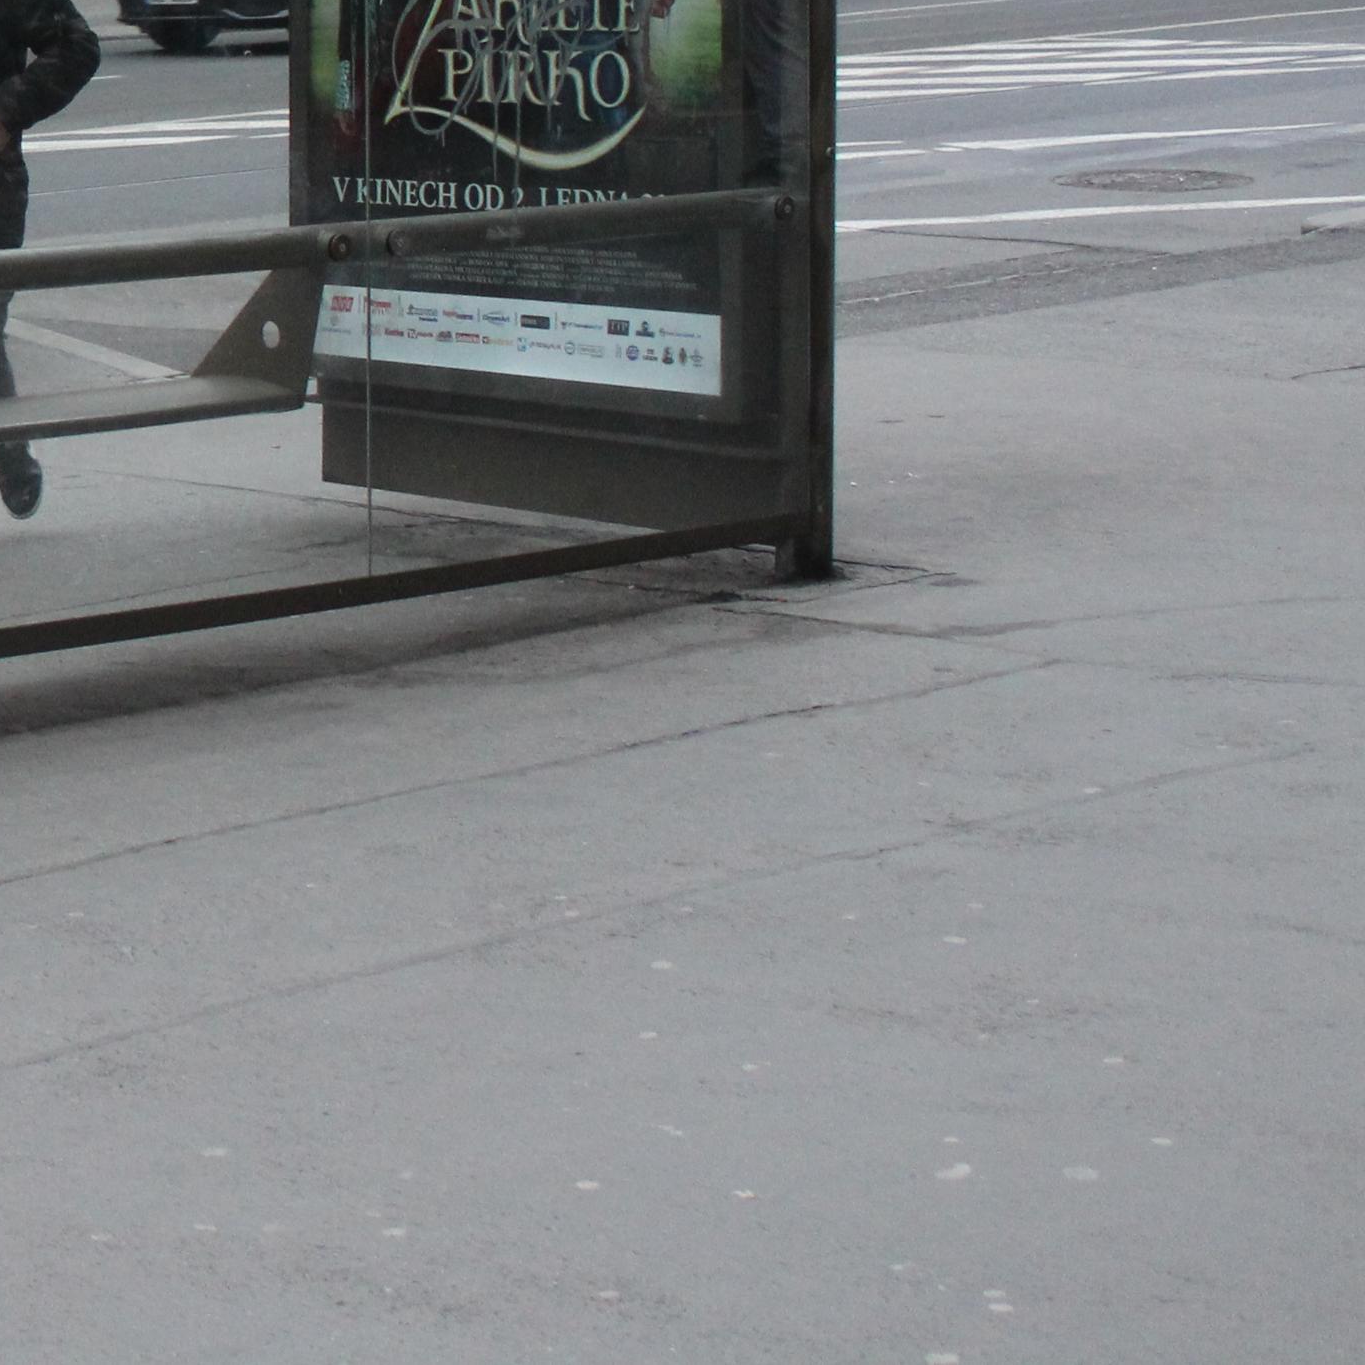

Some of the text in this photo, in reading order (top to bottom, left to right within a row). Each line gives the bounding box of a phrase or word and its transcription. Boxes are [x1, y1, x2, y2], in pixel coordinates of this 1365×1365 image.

[332, 176, 350, 202] V
[357, 178, 457, 209] KINECH
[464, 183, 504, 211] OD
